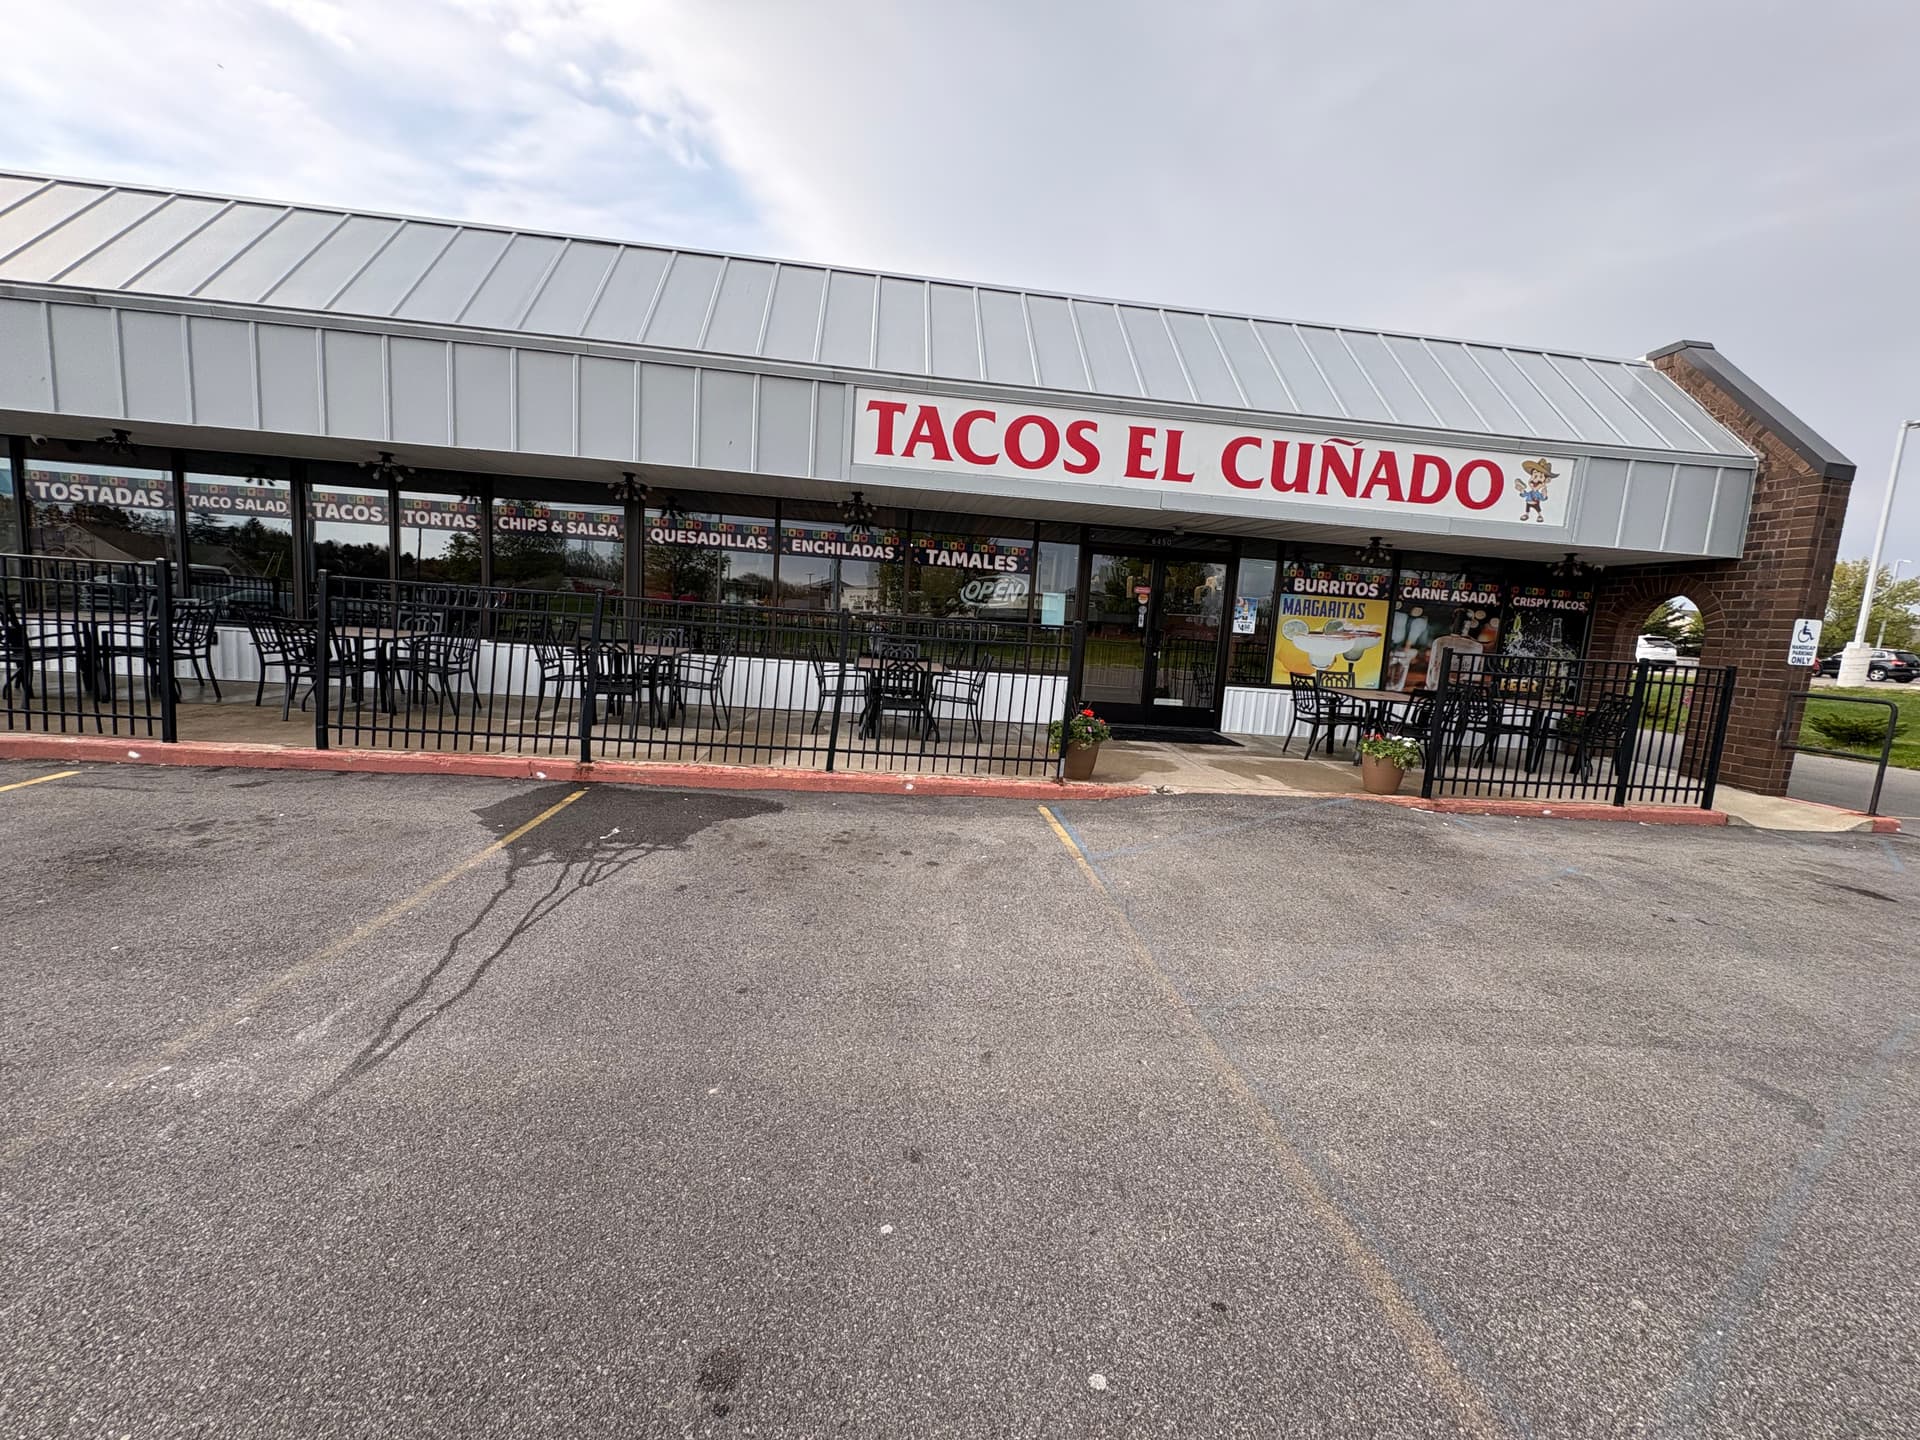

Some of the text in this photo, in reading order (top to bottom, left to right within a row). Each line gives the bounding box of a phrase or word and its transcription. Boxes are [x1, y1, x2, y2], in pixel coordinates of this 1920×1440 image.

[866, 400, 1504, 510] TACOS EL CUÑADO
[34, 481, 164, 508] TOSTADAS
[189, 494, 287, 513] TACO SALAD
[312, 502, 383, 522] TACOS
[404, 510, 476, 529] TORTAS
[498, 516, 618, 537] CHIPS & SALSA
[651, 528, 767, 550] QUESADILLAS
[792, 539, 894, 559] ENCHILADAS
[926, 549, 1018, 572] TAMALES
[965, 579, 1021, 601] OPEN
[1294, 578, 1379, 597] BURRITOS
[1403, 586, 1497, 604] CARNE ASADA
[1283, 598, 1366, 619] MARGARITAS
[1513, 597, 1586, 610] CRISPY TACOS
[1792, 656, 1811, 664] ONLY
